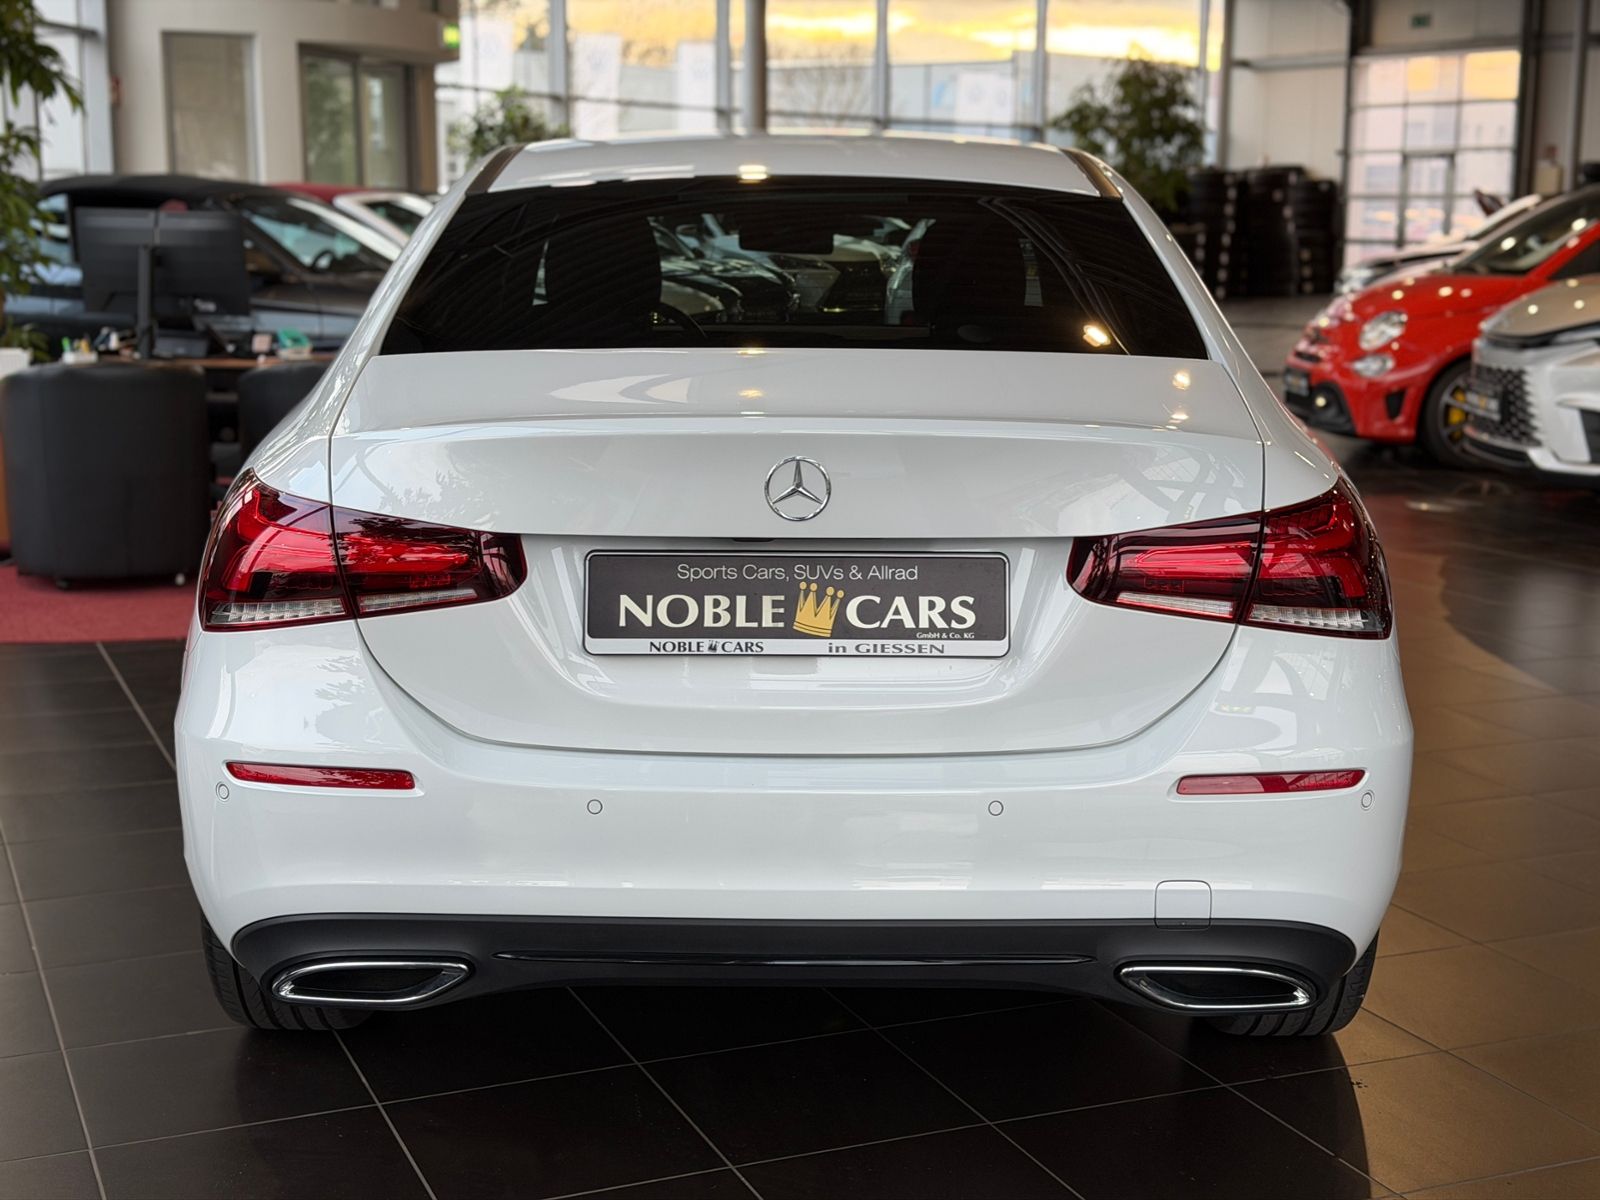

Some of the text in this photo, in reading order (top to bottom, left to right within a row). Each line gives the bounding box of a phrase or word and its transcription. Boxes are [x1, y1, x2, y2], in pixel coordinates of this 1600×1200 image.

[677, 564, 918, 582] Sports Cars, SUVs & Allrad
[619, 594, 976, 629] NOBLE CARS
[650, 641, 764, 653] NOBLE CARS
[828, 643, 945, 654] in GIESSEN
